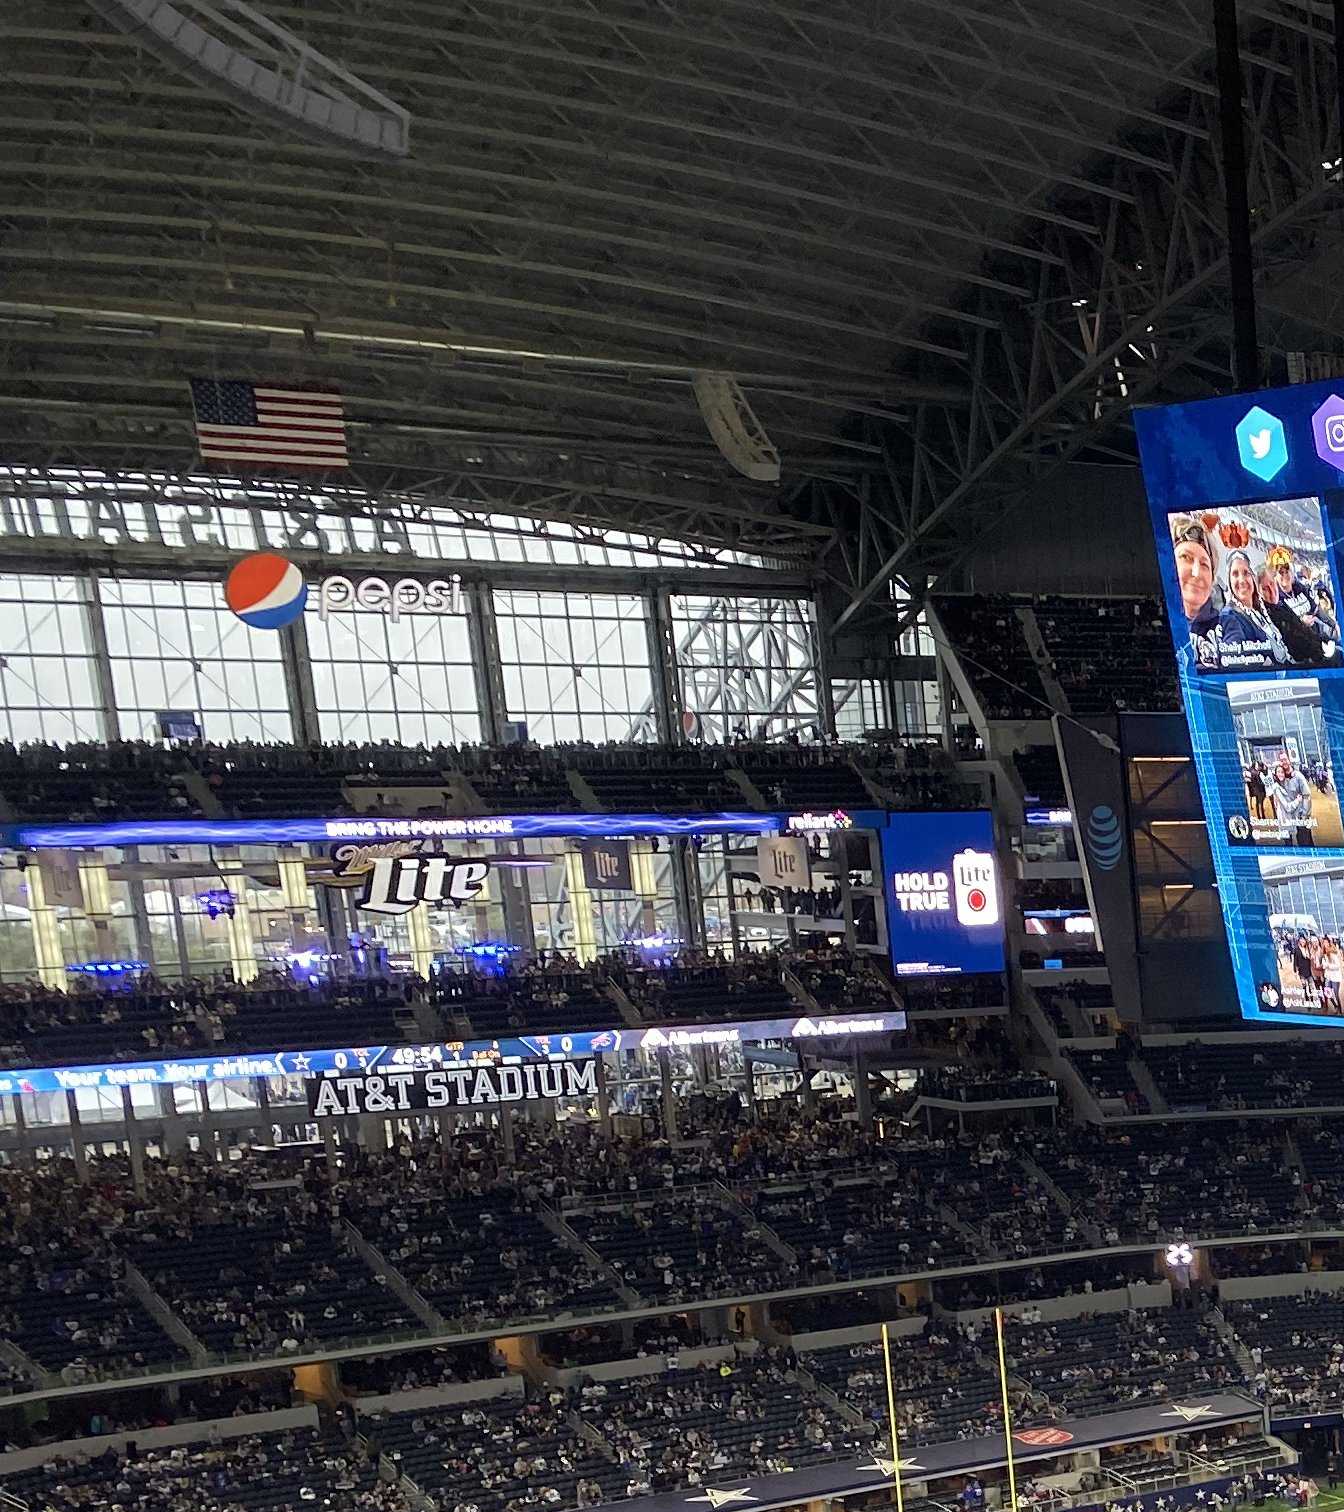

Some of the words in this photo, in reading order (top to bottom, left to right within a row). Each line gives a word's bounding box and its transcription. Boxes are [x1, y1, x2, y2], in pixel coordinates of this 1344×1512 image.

[319, 574, 462, 623] pepsi
[326, 822, 377, 837] BRING
[378, 822, 409, 836] THE
[411, 821, 467, 835] POWER
[469, 820, 513, 833] HOME
[789, 813, 834, 830] reliant
[594, 851, 619, 883] Lite
[770, 848, 796, 880] Lite
[959, 864, 991, 886] Lite
[360, 857, 488, 914] Lite
[894, 872, 949, 892] HOLD
[897, 892, 949, 911] TRUE
[561, 1036, 573, 1052] 0
[334, 1052, 347, 1069] 0
[392, 1045, 443, 1067] 49:54
[53, 1069, 102, 1088] Your
[106, 1067, 161, 1083] team.
[163, 1063, 209, 1082] Your
[212, 1057, 277, 1078] airline.
[314, 1073, 415, 1117] AT&T
[427, 1060, 599, 1106] STADIUM
